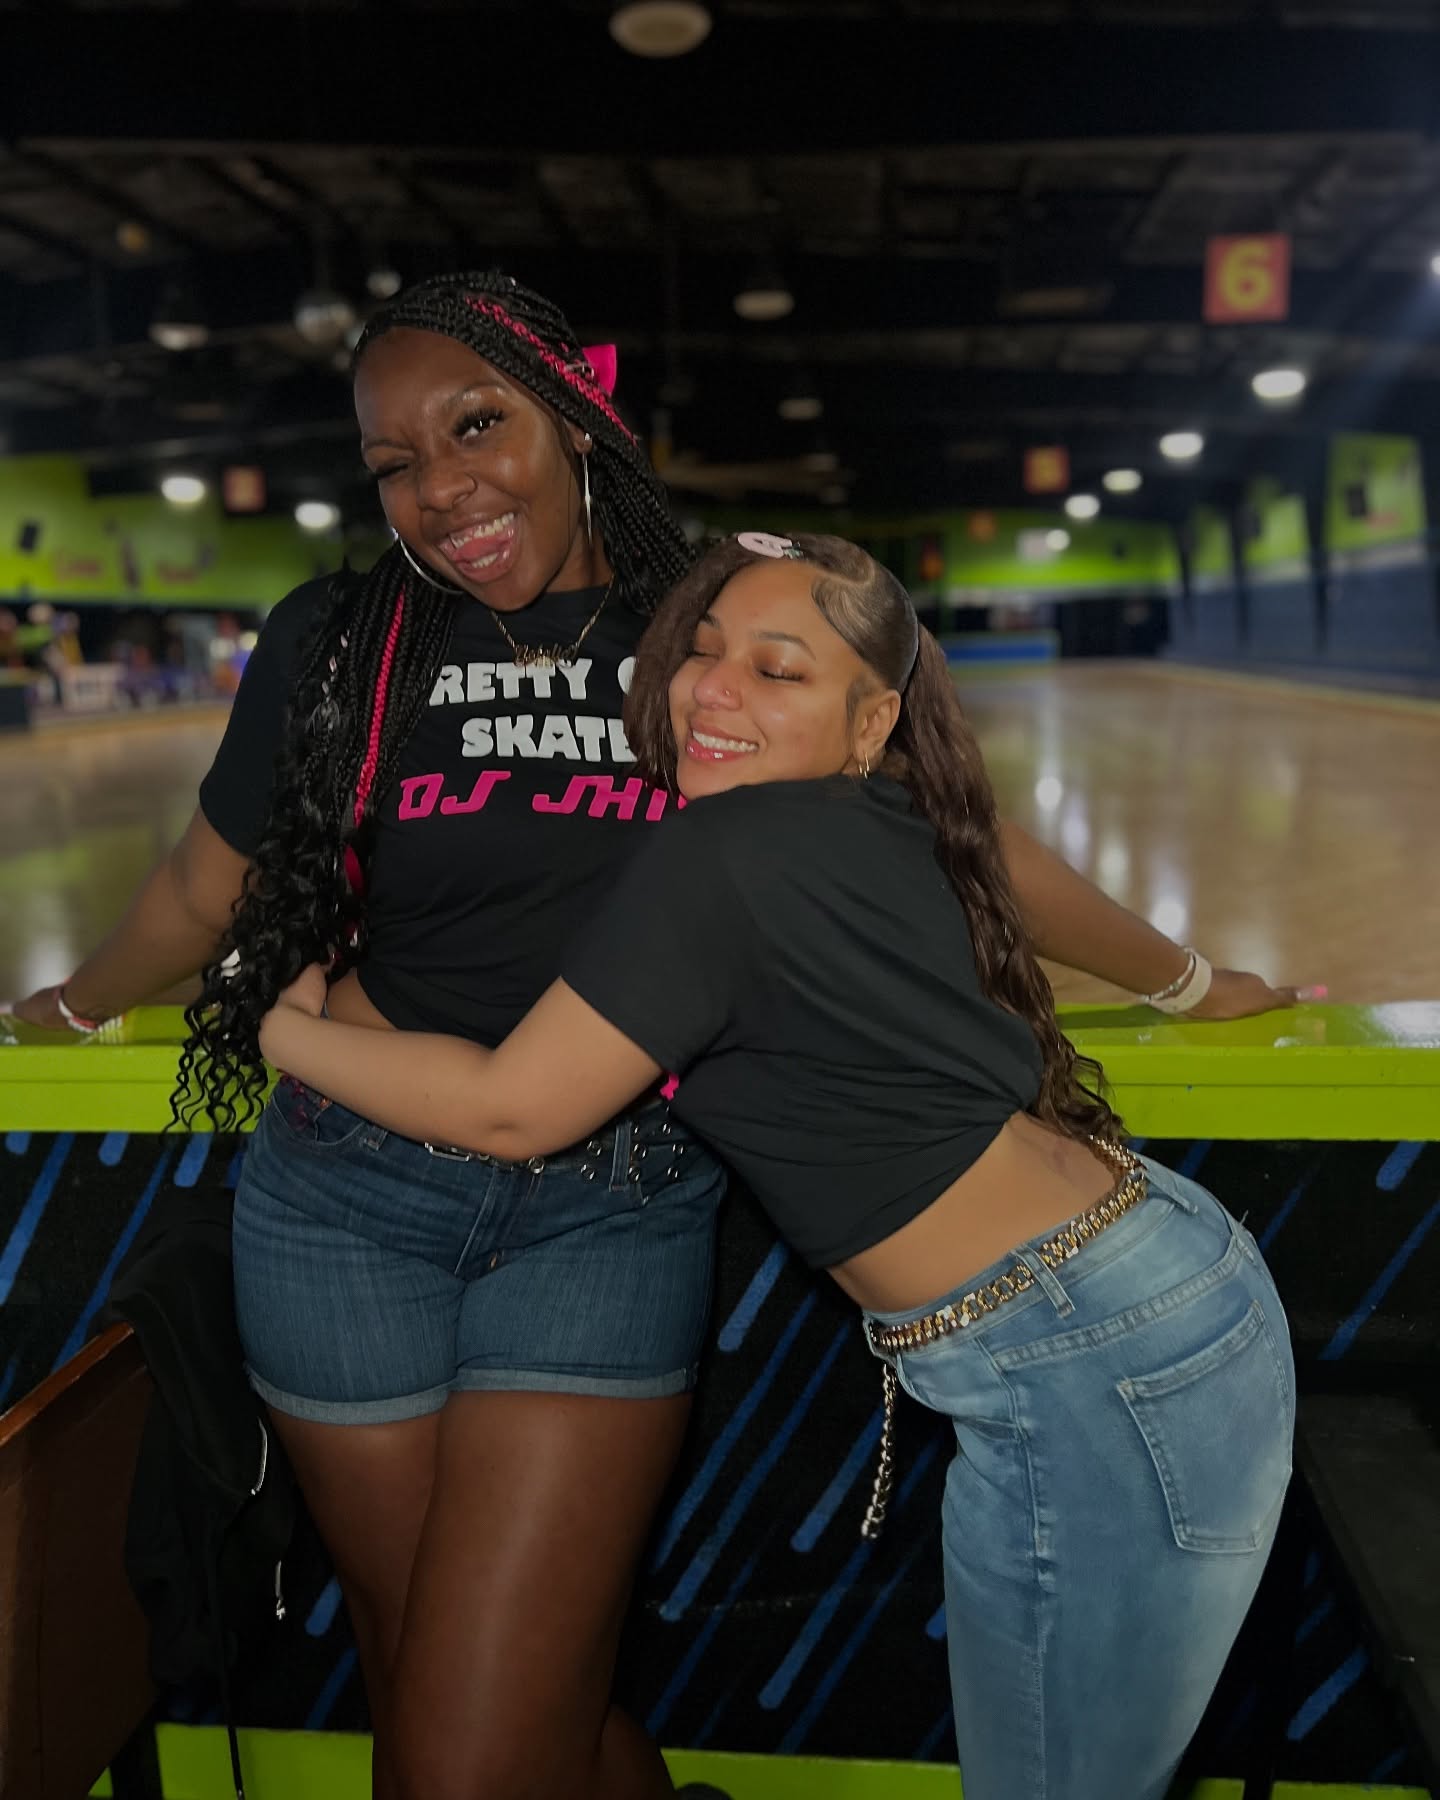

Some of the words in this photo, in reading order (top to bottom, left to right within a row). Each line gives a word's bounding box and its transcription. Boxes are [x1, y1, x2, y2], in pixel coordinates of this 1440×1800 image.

[1218, 240, 1275, 312] 6
[429, 658, 593, 706] RETTY
[399, 770, 511, 821] DJ
